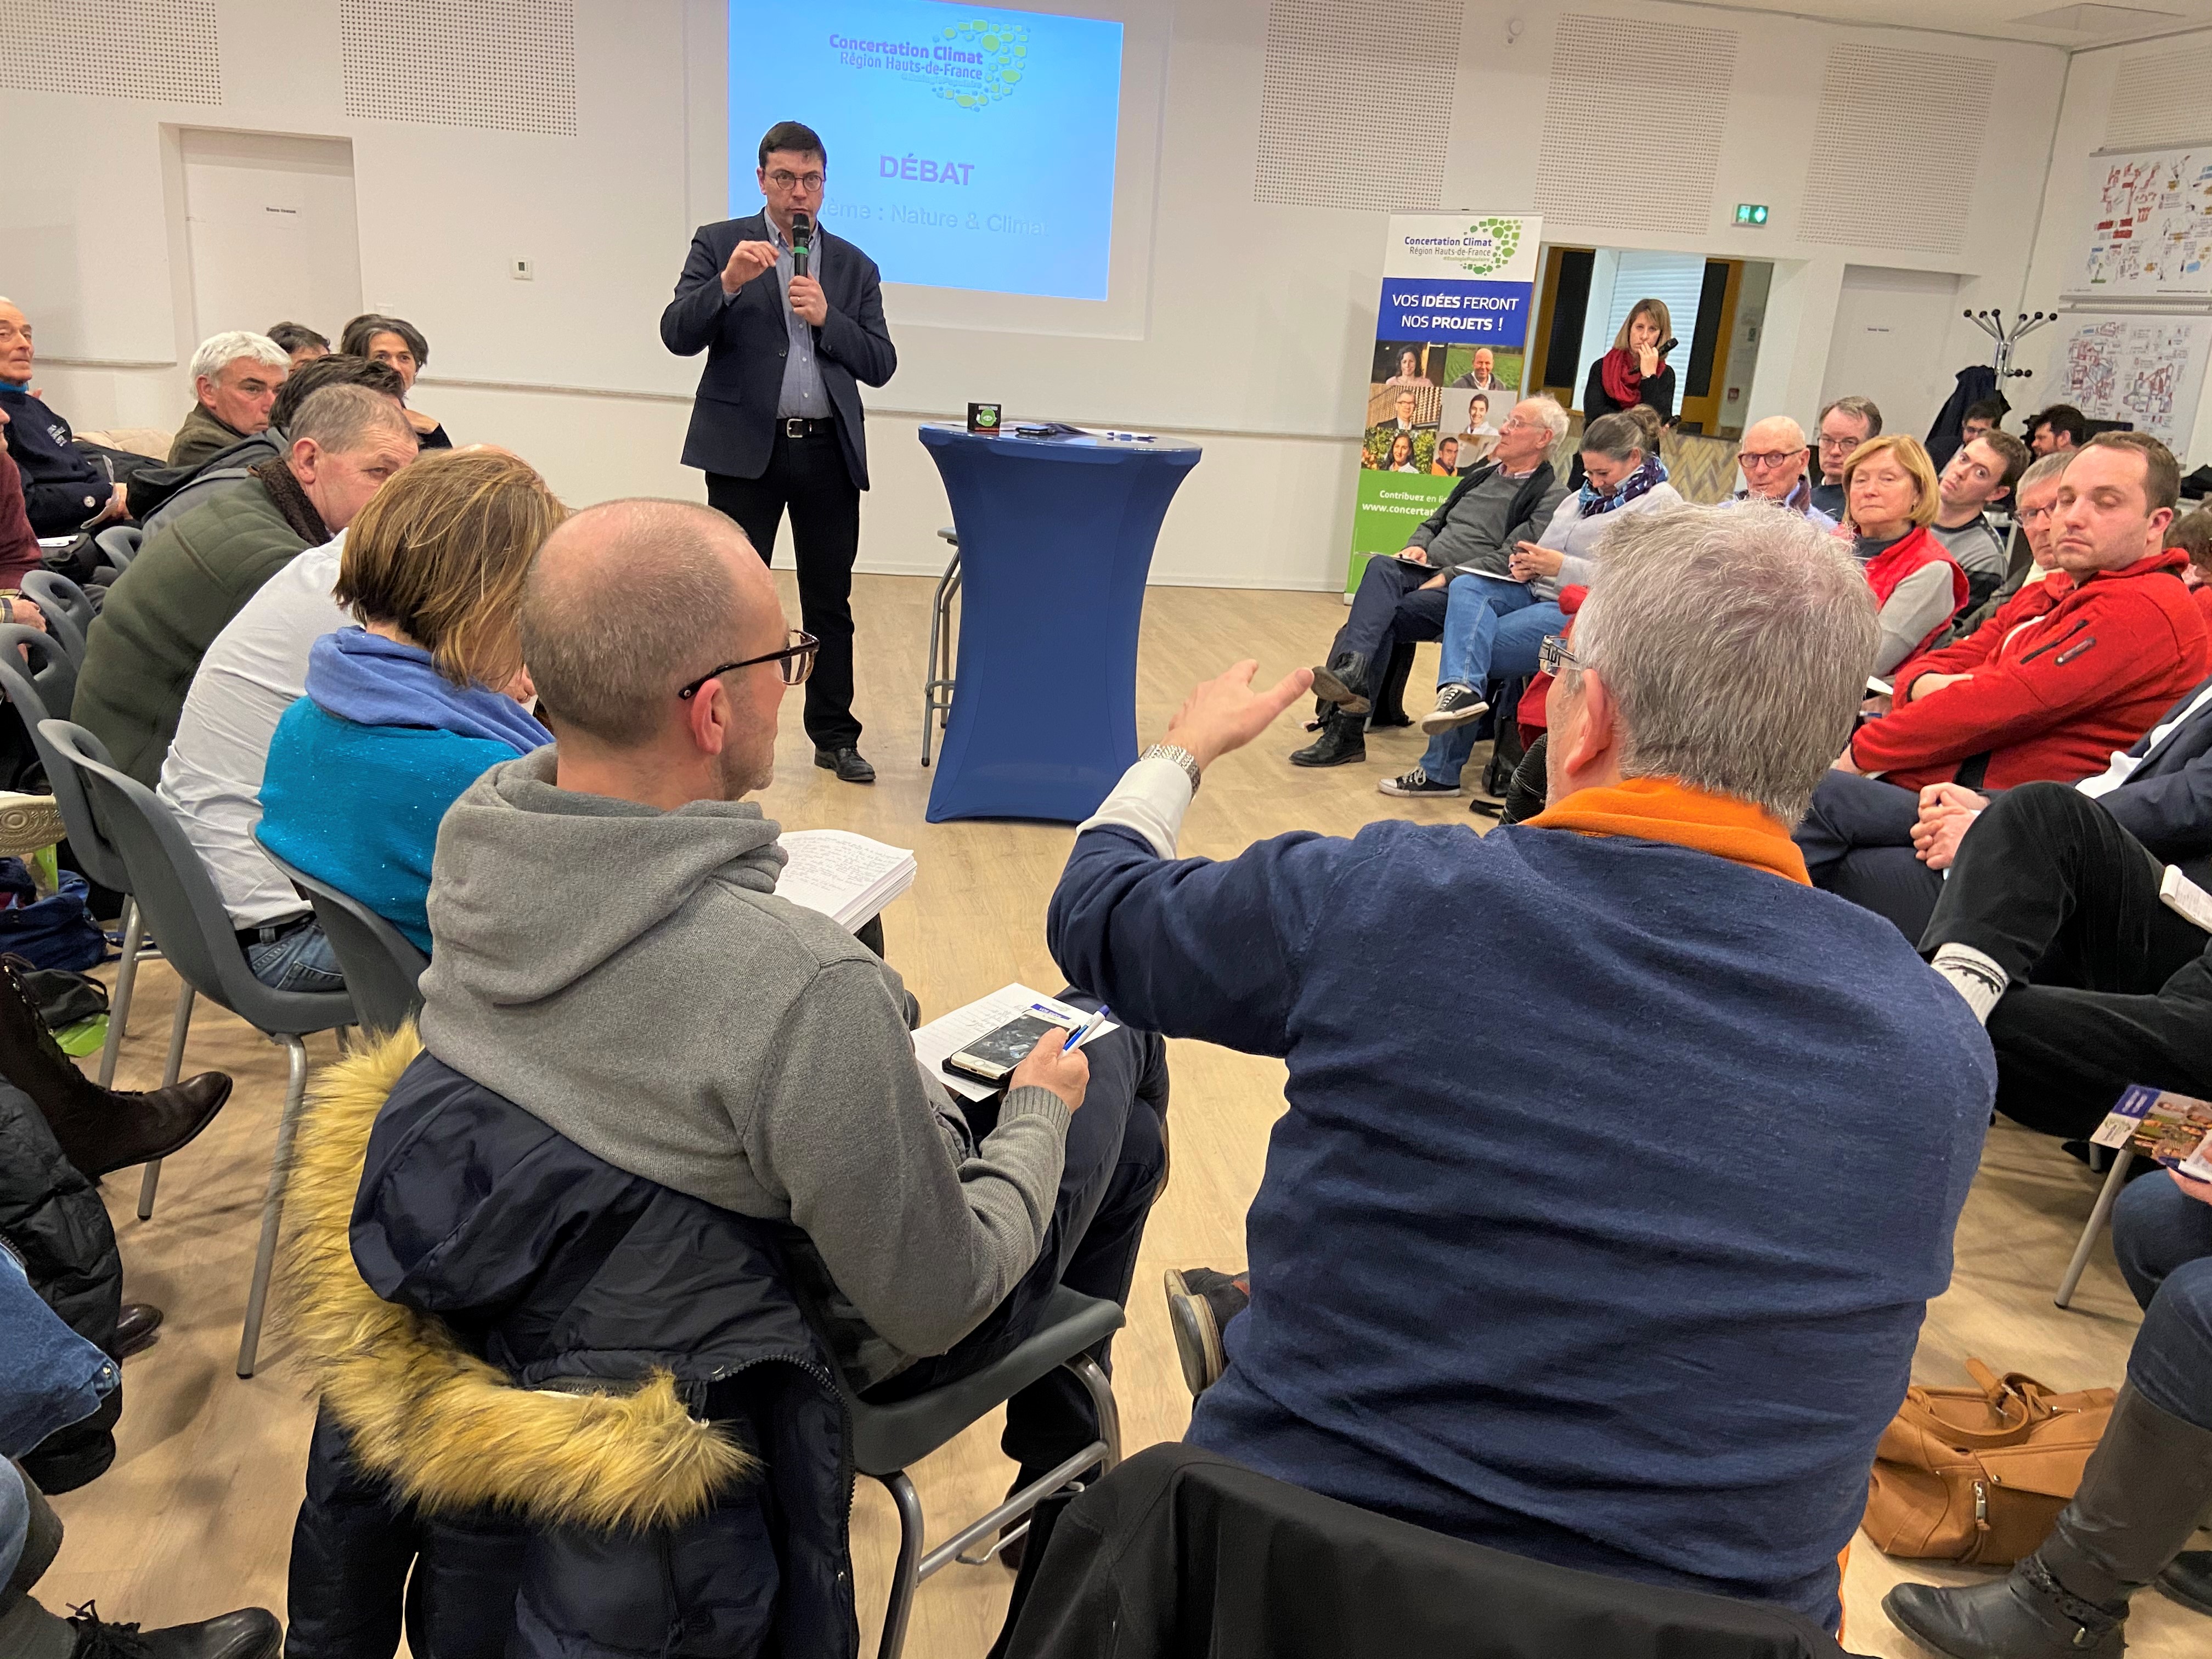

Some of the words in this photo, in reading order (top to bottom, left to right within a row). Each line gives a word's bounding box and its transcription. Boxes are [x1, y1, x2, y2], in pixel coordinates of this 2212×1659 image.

[830, 34, 929, 58] Concertation
[934, 46, 984, 65] Climat
[840, 52, 882, 69] Région
[886, 56, 983, 80] Hauts-de-France
[879, 153, 975, 185] DÉBAT
[822, 198, 871, 219] ème
[891, 205, 958, 228] Nature
[965, 212, 980, 229] &
[986, 214, 1049, 237] Climat
[1404, 236, 1460, 246] Concertation
[1463, 238, 1492, 247] Climat
[1409, 246, 1433, 256] Région
[1435, 248, 1491, 256] Hauts-de-France
[1392, 294, 1419, 307] VOS
[1421, 293, 1461, 309] IDÉES
[1463, 297, 1520, 311] FERONT
[1401, 315, 1429, 328] NOS
[1431, 316, 1493, 331] PROJETS
[1498, 317, 1504, 331] !
[1379, 490, 1424, 501] Contribuez
[1362, 503, 1438, 516] www.concertat
